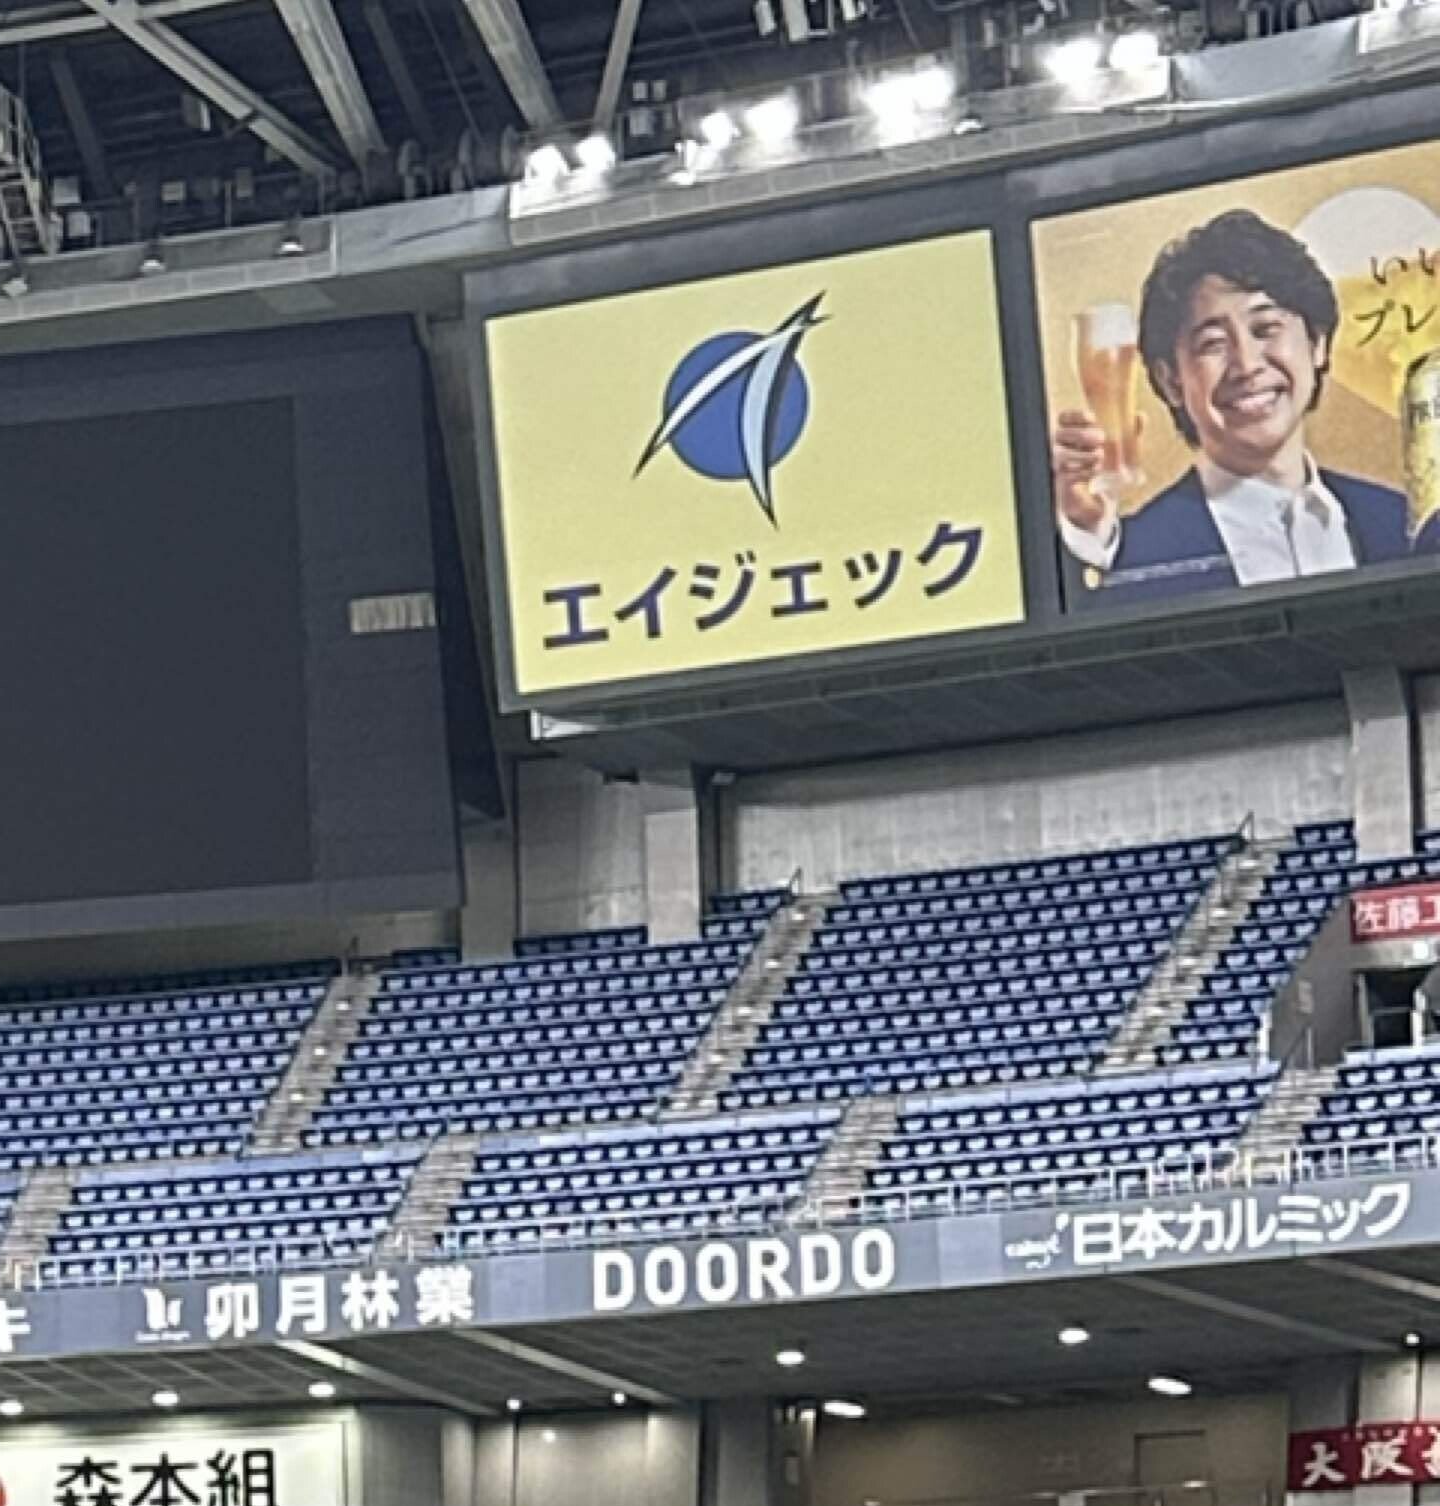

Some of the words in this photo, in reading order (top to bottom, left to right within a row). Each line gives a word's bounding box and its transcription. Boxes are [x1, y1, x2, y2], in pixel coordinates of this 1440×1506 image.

[541, 521, 984, 650] エイジェック
[1072, 1181, 1411, 1267] 日本カルミック
[592, 1228, 895, 1311] DOORDO
